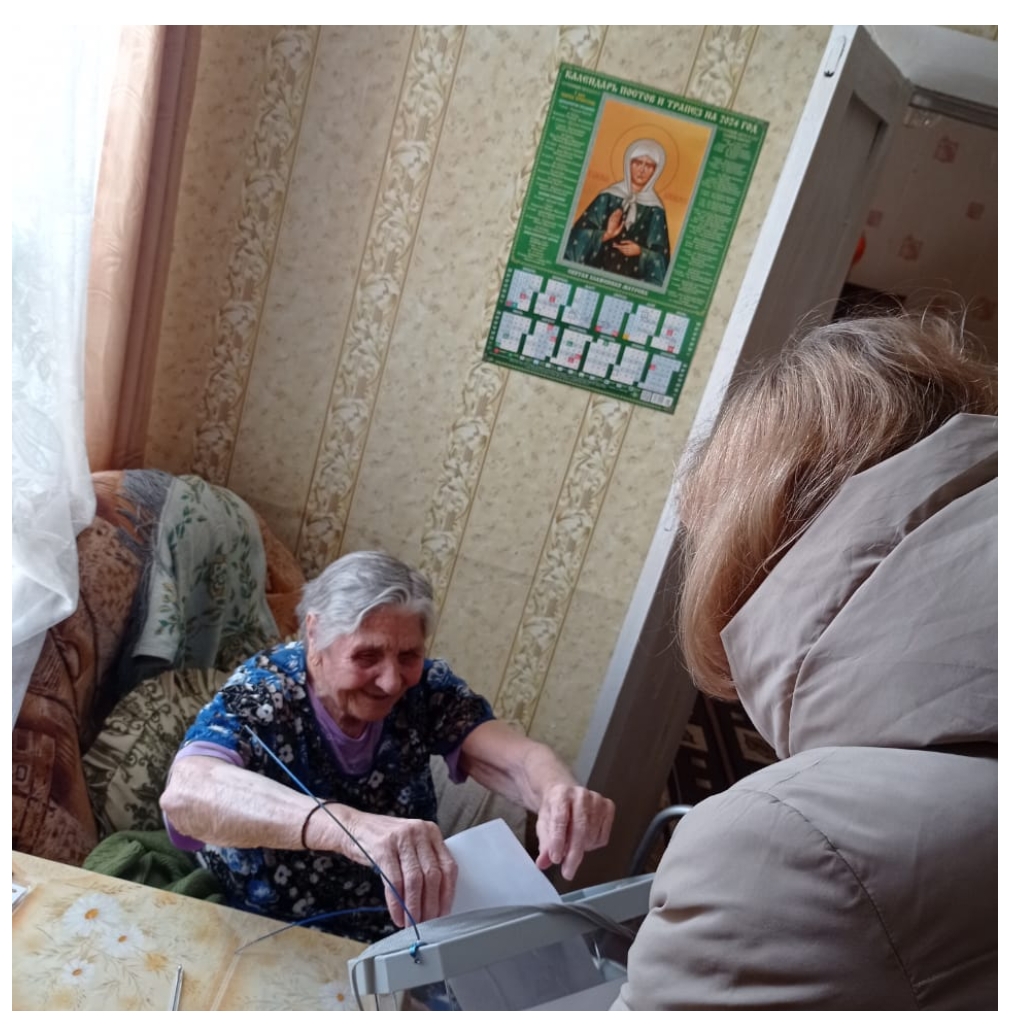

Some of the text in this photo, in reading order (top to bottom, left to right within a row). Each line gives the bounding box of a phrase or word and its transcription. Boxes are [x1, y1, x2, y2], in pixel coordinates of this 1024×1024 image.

[565, 69, 618, 92] КАЛЕНДАРЬ
[620, 86, 656, 104] ПОСТОВ
[657, 96, 666, 107] И
[667, 99, 703, 117] ТРАПЕЗ
[704, 110, 718, 121] НА
[740, 121, 758, 134] ГОД
